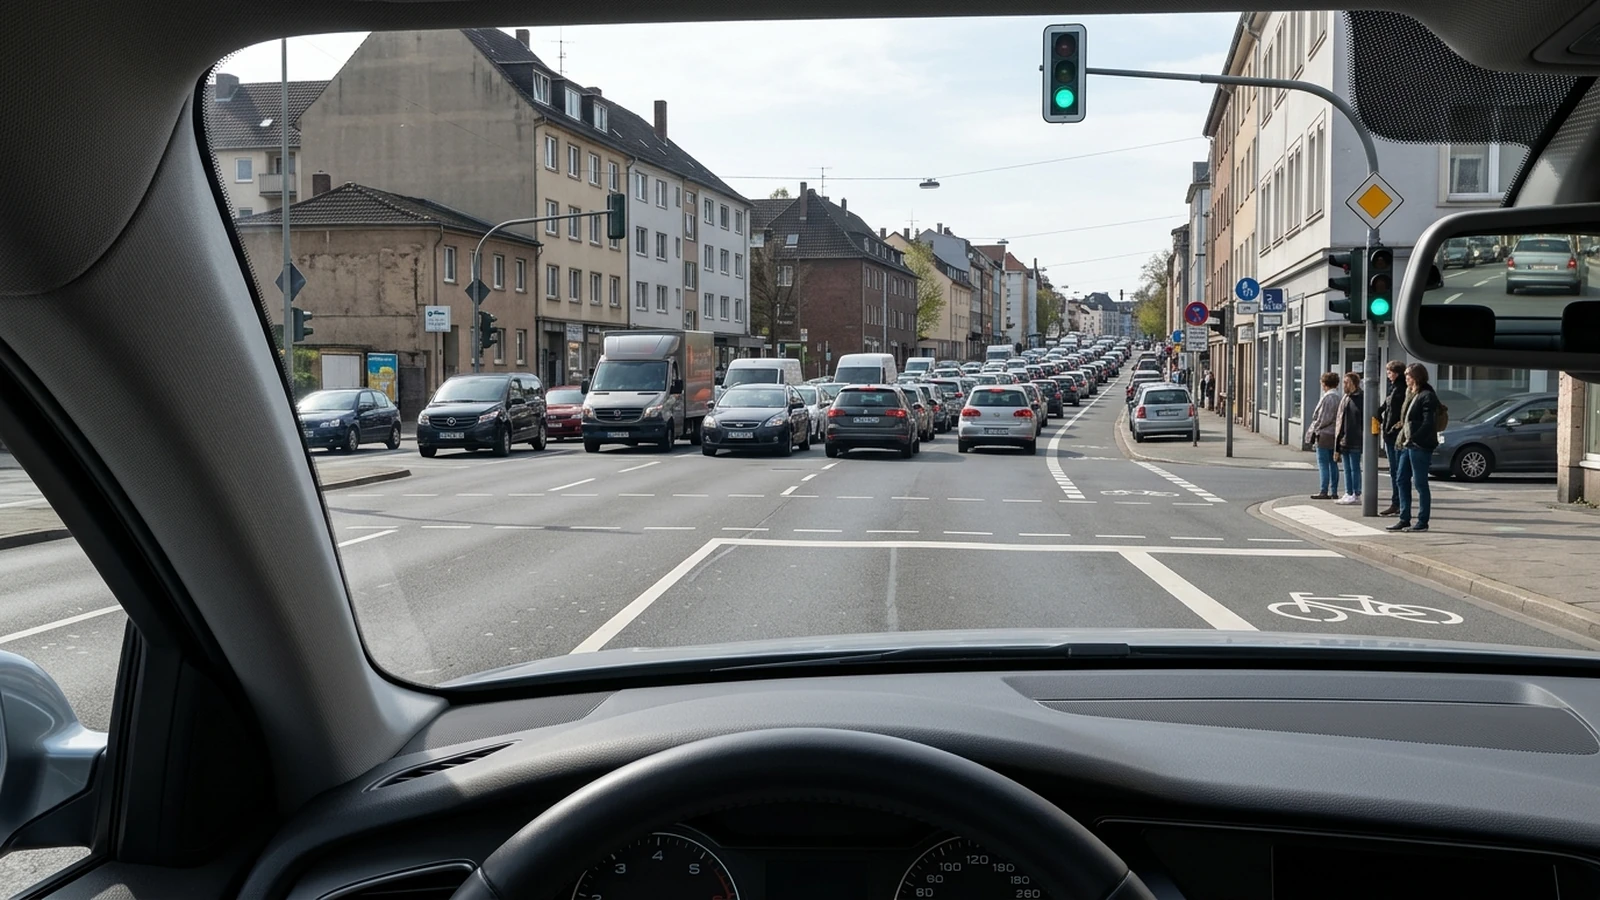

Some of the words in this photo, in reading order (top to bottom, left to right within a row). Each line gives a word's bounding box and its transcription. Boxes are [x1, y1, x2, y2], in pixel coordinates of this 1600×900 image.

[652, 850, 663, 861] 4
[966, 855, 989, 865] 120
[614, 863, 627, 874] 3
[939, 862, 962, 872] 100
[1010, 875, 1030, 885] 180
